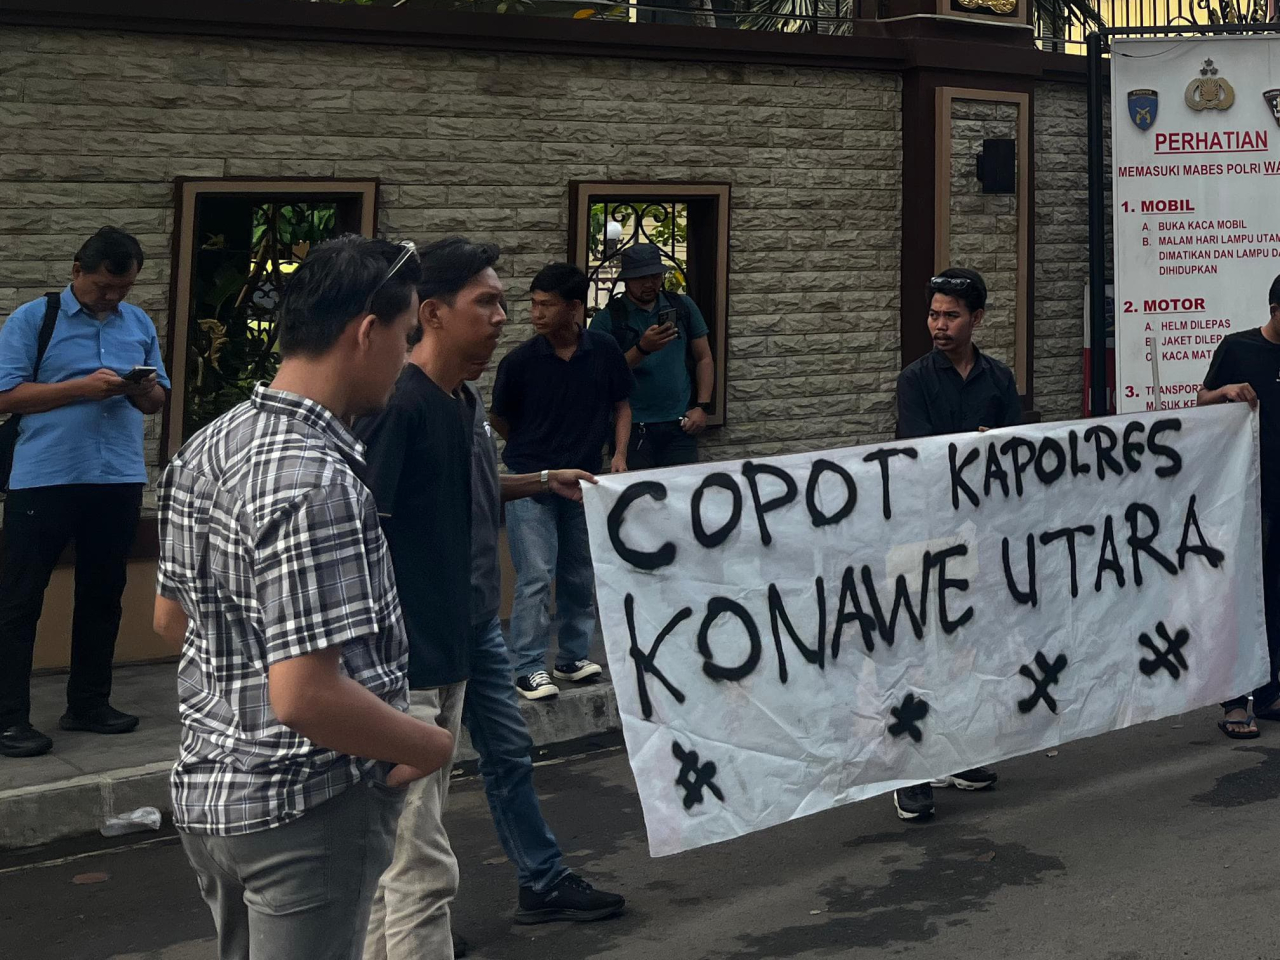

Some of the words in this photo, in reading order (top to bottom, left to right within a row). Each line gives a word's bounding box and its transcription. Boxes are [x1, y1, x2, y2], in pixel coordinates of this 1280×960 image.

[1155, 130, 1267, 151] PERHATIAN
[1118, 165, 1180, 177] MEMASUKI
[1183, 164, 1223, 176] MABES
[1227, 163, 1261, 174] POLRI
[1121, 201, 1135, 213] 1.
[1141, 199, 1195, 212] MOBIL
[1142, 222, 1151, 231] A.
[1158, 221, 1185, 231] BUKA
[1188, 220, 1214, 230] KACA
[1217, 220, 1247, 229] MOBIL
[1142, 237, 1151, 246] B.
[1159, 235, 1193, 246] MALAM
[1196, 235, 1218, 245] HARI
[1221, 234, 1254, 244] LAMPU
[1159, 250, 1210, 260] DIMATIKAN
[1213, 249, 1233, 259] DAN
[1236, 248, 1269, 258] LAMPU
[1159, 265, 1217, 275] DIHIDUPKAN
[1123, 301, 1138, 313] 2.
[1143, 298, 1206, 312] MOTOR
[1161, 320, 1188, 331] HELM
[1190, 319, 1231, 330] DILEPAS
[1161, 336, 1192, 346] JAKET
[1195, 334, 1224, 344] DILEP
[1162, 351, 1189, 361] KACA
[1192, 350, 1213, 360] MAT
[1125, 386, 1140, 398] 3.
[1146, 400, 1180, 411] MSUK
[606, 447, 918, 572] COPOT
[948, 418, 1183, 511] KAPOLRES
[624, 543, 974, 722] KONAWE
[1001, 493, 1225, 609] UTARA
